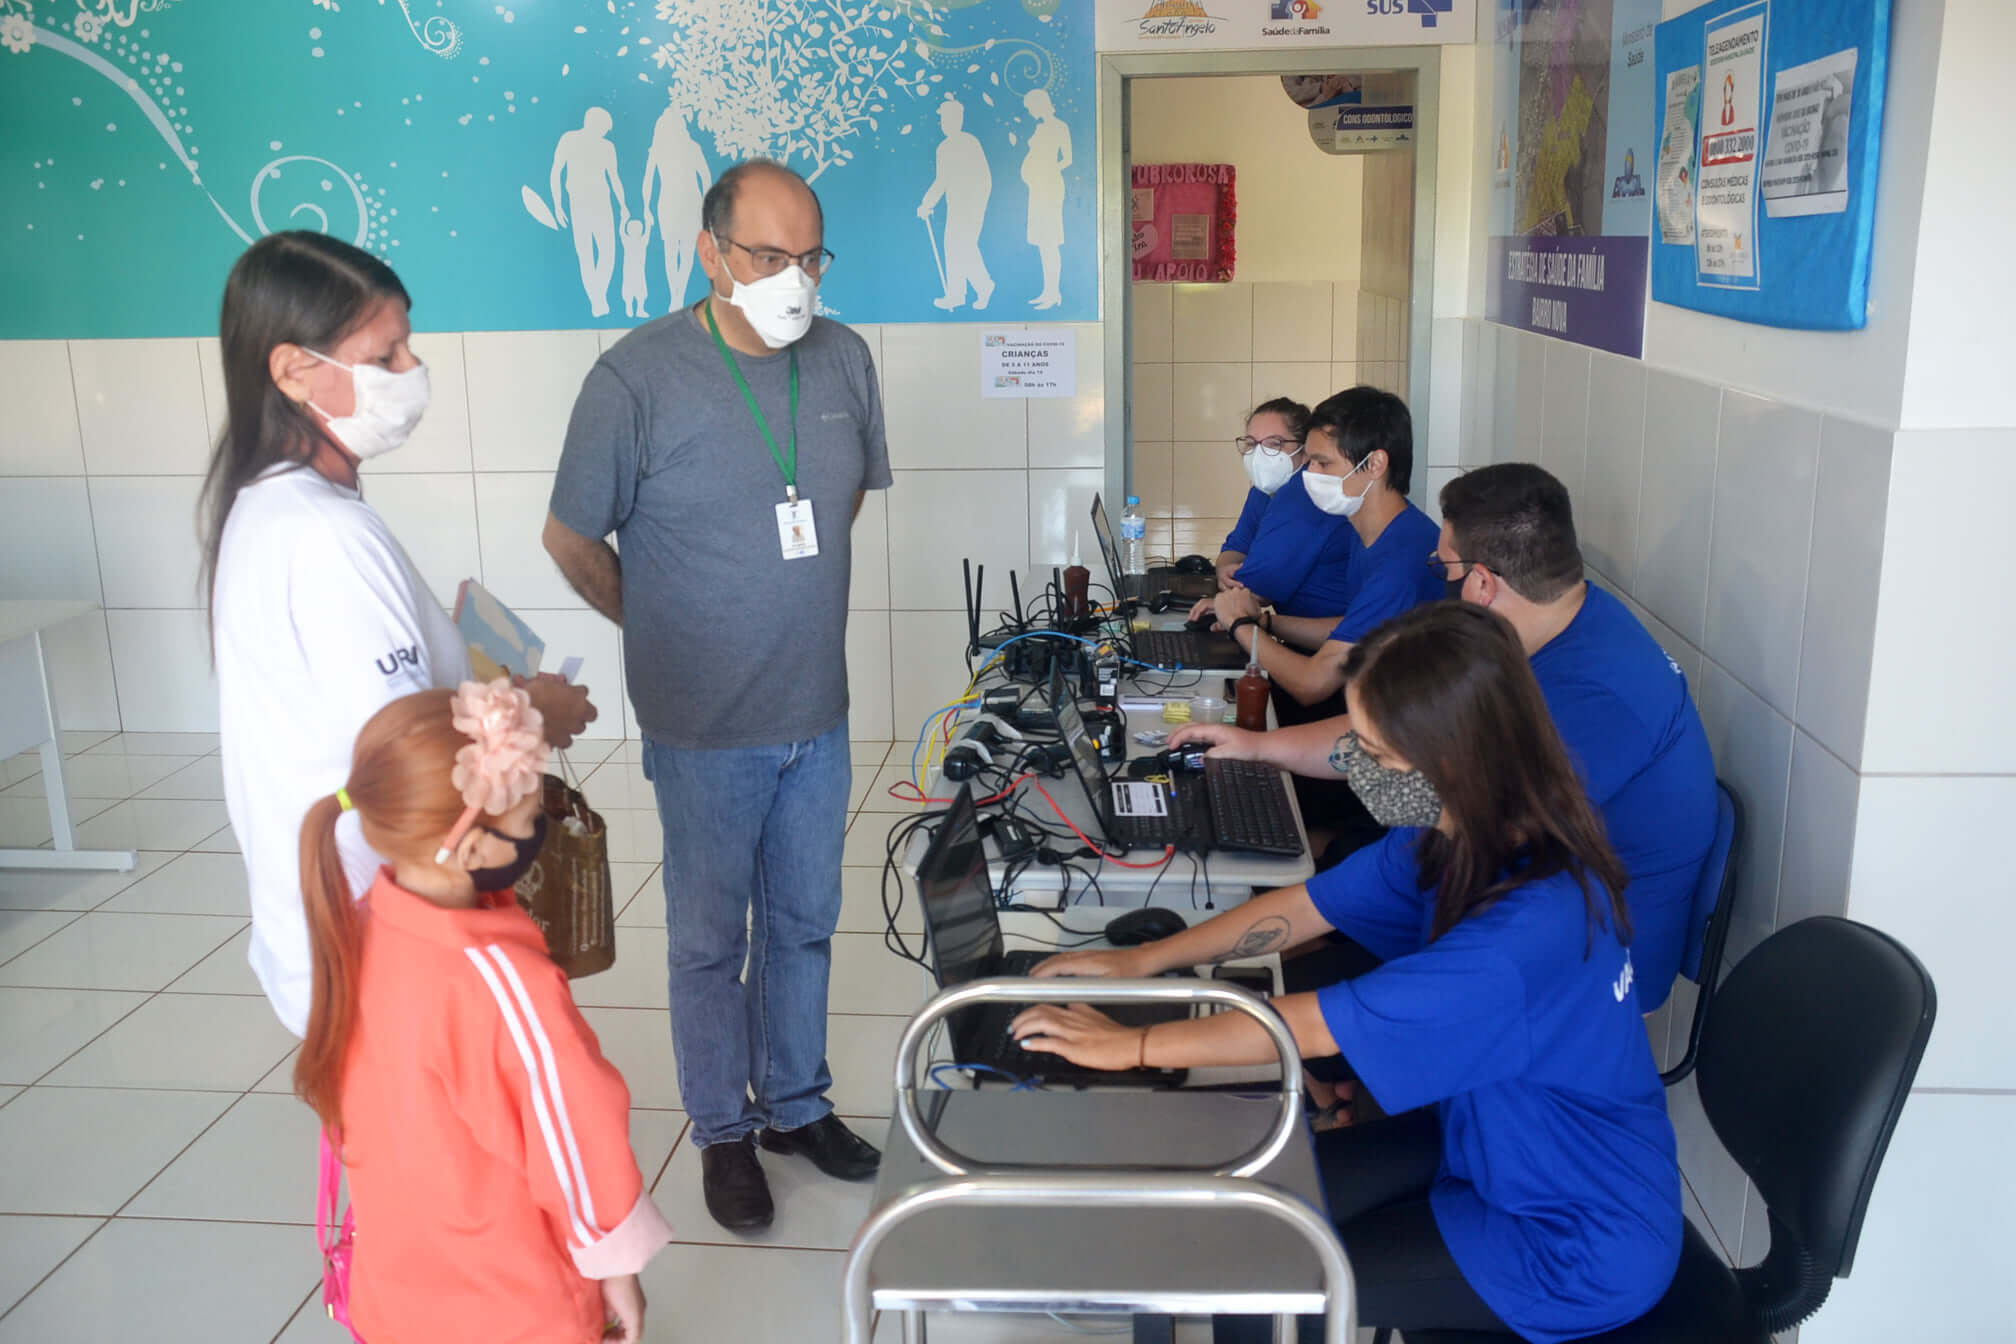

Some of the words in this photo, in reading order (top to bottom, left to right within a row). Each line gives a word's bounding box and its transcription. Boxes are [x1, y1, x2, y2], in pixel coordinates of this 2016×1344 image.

[1367, 0, 1404, 15] SUS
[1577, 247, 1605, 292] FAMÍLIA
[1001, 350, 1049, 358] CRIANÇAS
